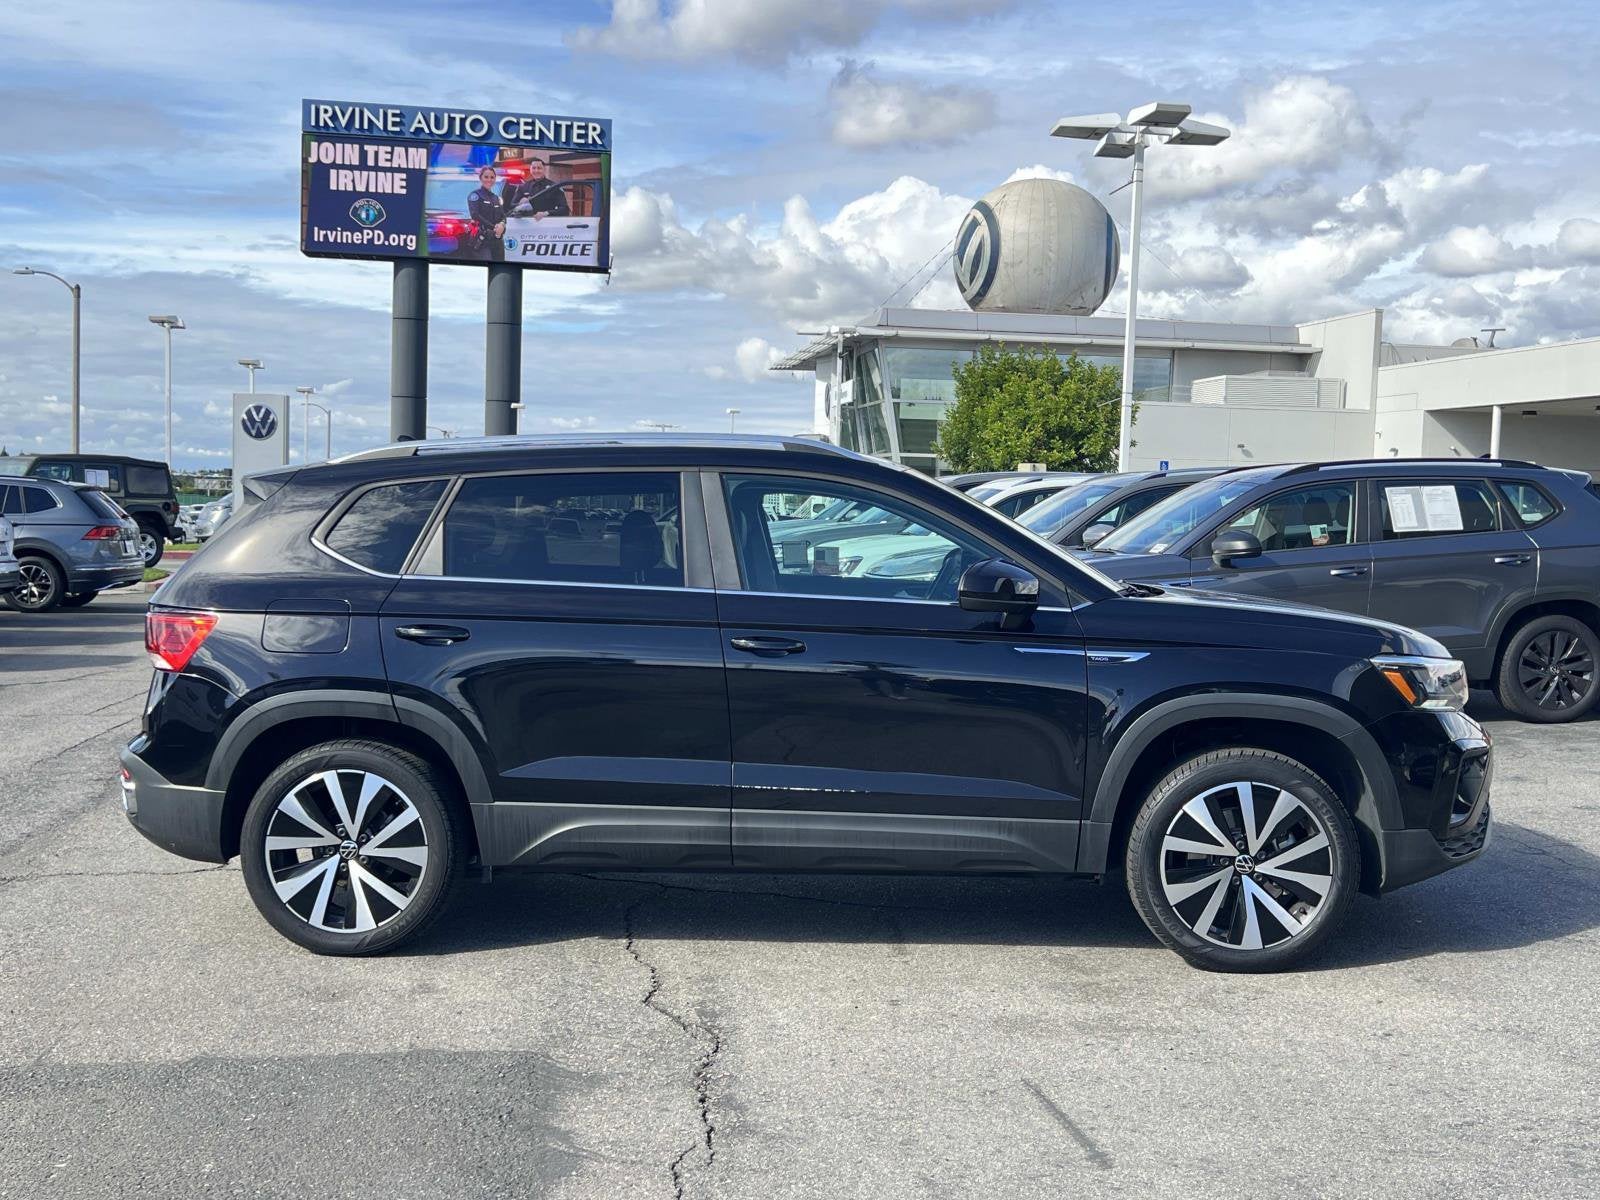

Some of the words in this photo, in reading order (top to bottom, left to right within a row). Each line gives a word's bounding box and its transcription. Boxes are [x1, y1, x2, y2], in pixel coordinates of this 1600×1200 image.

[310, 104, 401, 131] IRVINE
[409, 111, 489, 138] AUTO
[499, 116, 603, 145] CENTER
[308, 141, 360, 165] JOIN
[363, 144, 428, 170] TEAM
[329, 168, 407, 195] IRVINE
[313, 226, 417, 251] IrvinePD.org
[521, 243, 593, 257] POLICE
[241, 402, 278, 441] VW
